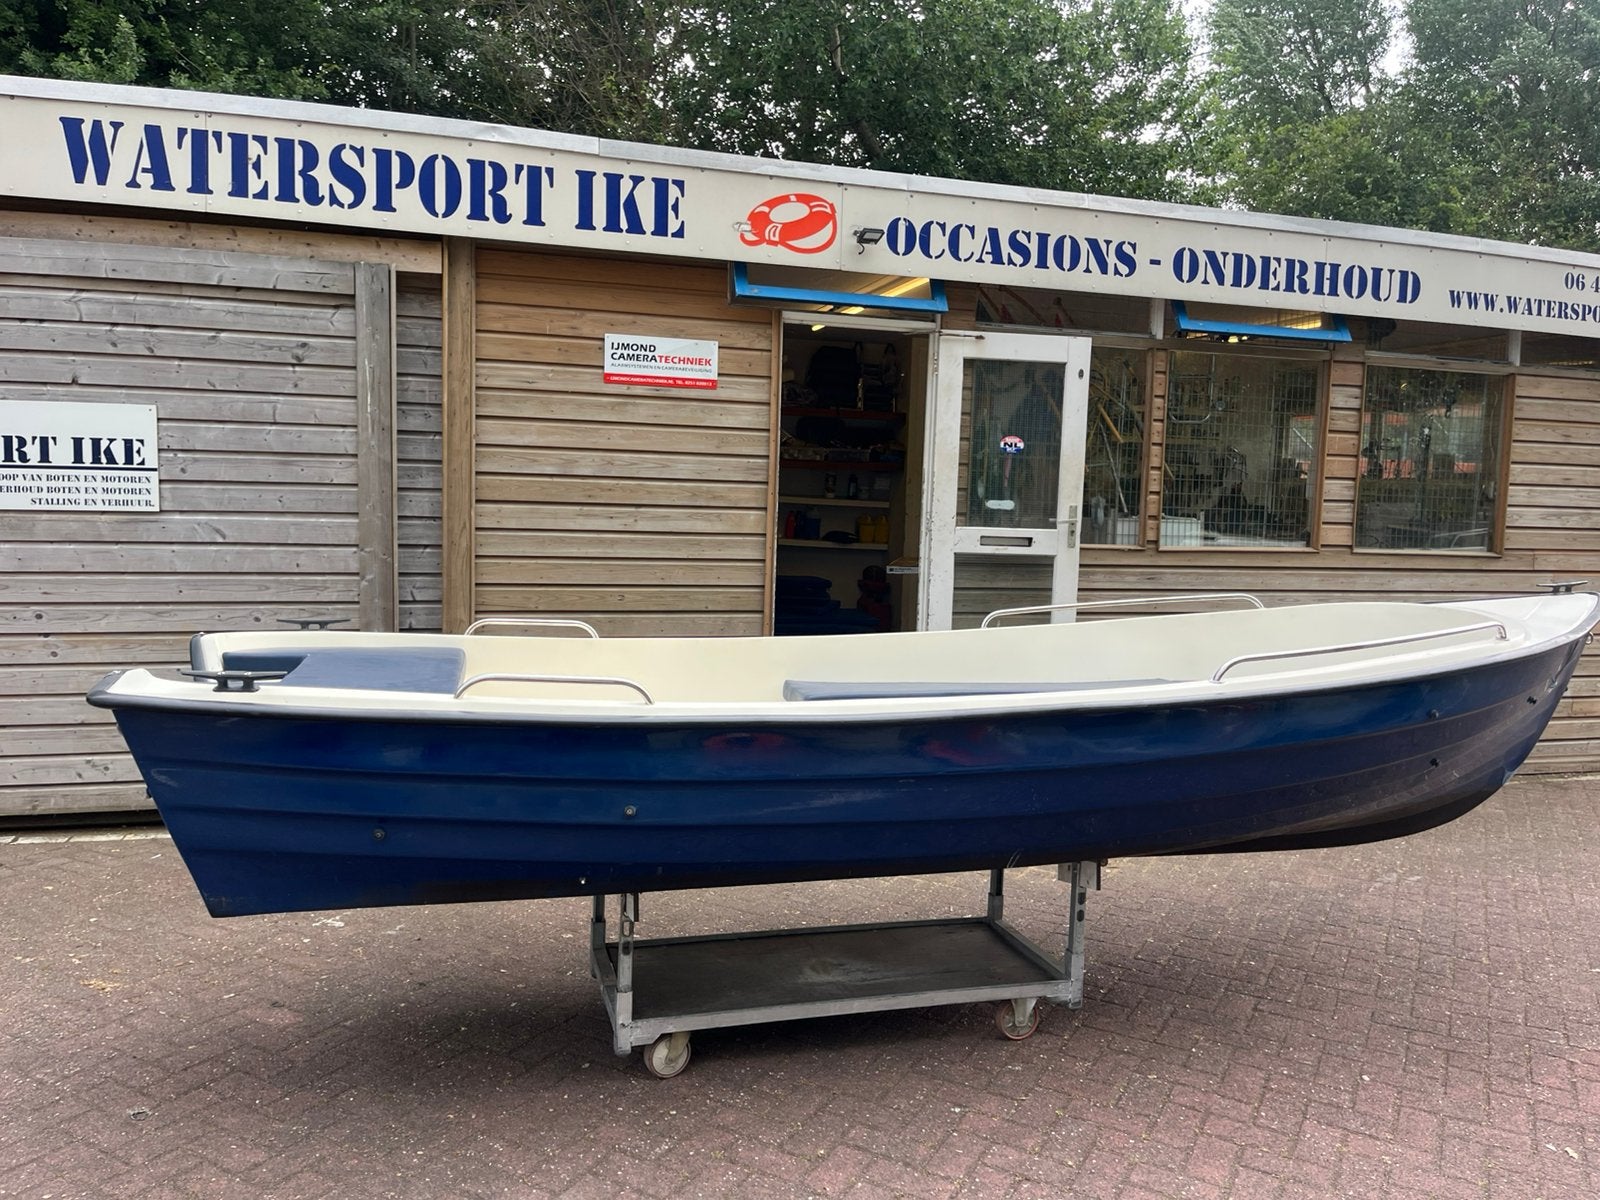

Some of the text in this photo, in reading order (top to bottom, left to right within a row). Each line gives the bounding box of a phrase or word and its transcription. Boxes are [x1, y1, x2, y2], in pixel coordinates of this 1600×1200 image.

[58, 115, 687, 239] WATERSPORT IKE
[886, 215, 1422, 305] OCCASIONS - ONDERHOUD
[1564, 271, 1600, 293] 06 4
[1448, 289, 1600, 324] WWW.WATERSPO
[611, 341, 657, 353] IJMOND
[610, 352, 712, 367] CAMERATECHNIEK
[1, 435, 146, 467] RT IKE
[22, 473, 43, 482] VAN
[46, 474, 81, 483] BOTEN
[84, 474, 98, 483] EN
[101, 475, 152, 484] MOTOREN
[0, 485, 152, 496] ERHOUD BOTEN EN MOTOREN
[31, 497, 82, 506] STALLING
[84, 498, 98, 507] EN
